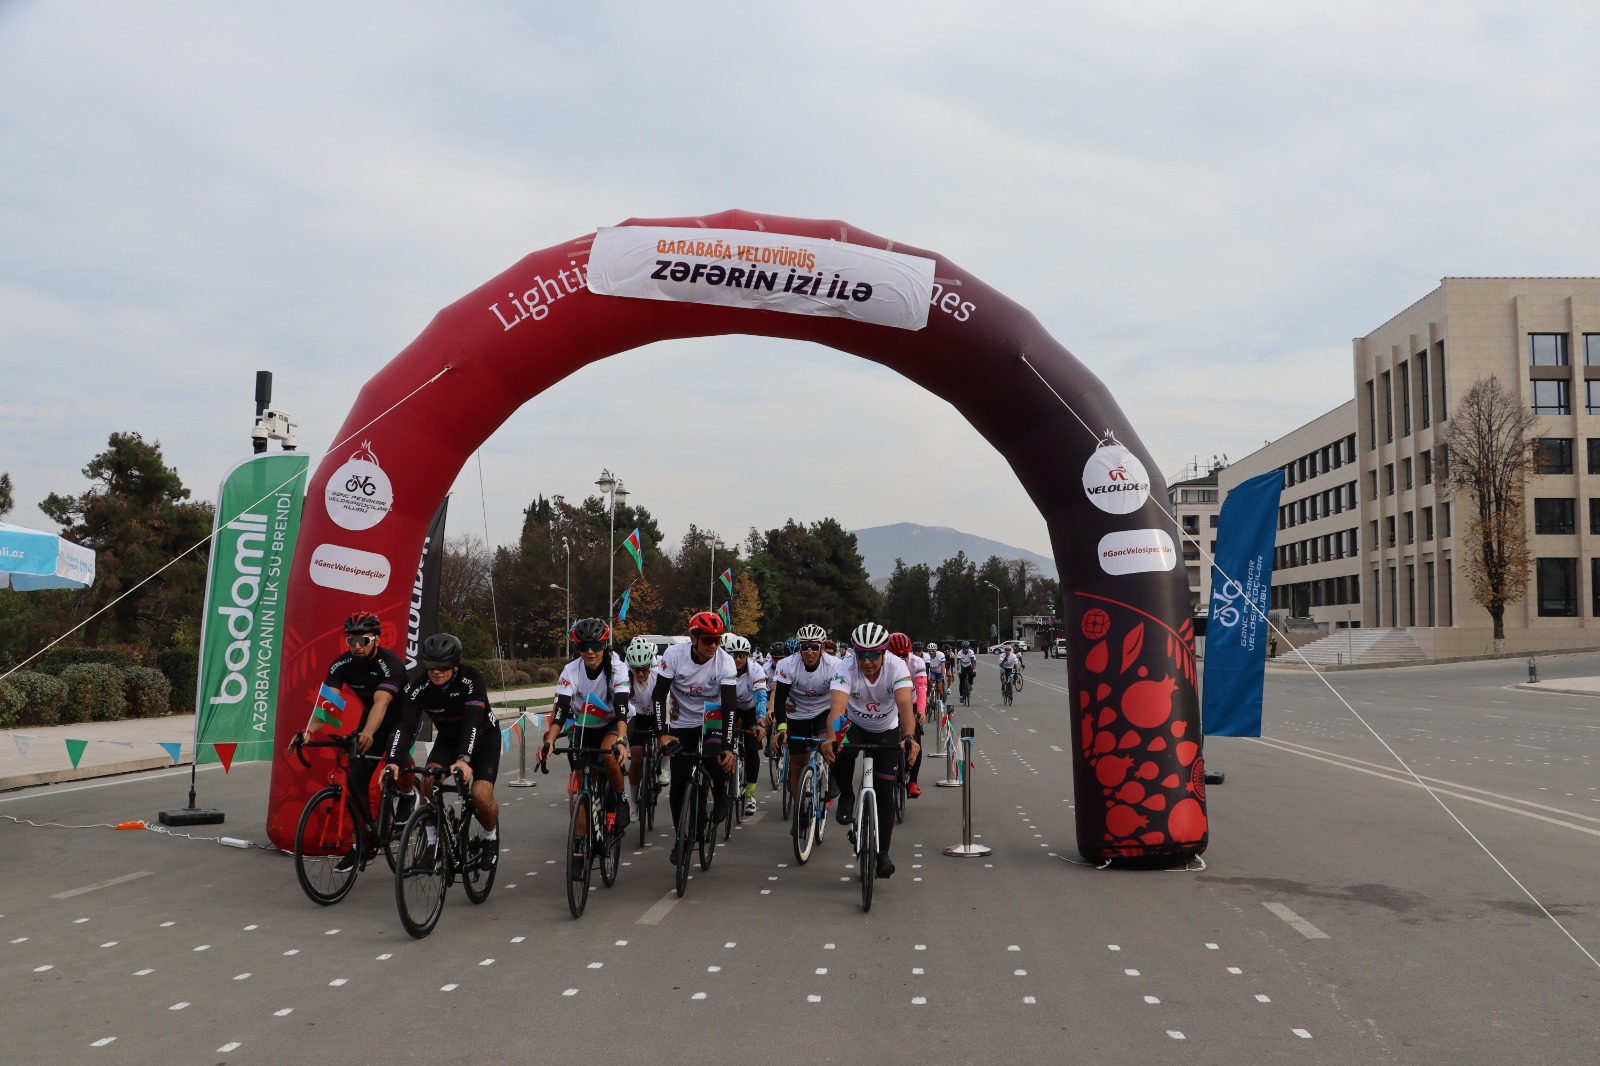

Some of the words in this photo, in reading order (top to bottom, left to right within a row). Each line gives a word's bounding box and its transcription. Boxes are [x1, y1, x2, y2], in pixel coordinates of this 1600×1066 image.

[656, 239, 732, 260] QARABAĞA
[737, 245, 816, 273] VELOYÜRÜŞ
[488, 260, 588, 332] Lighti
[650, 259, 779, 292] ZƏFƏRİN
[783, 268, 824, 297] İZİ
[826, 273, 873, 303] İLƏ
[271, 492, 292, 551] BRENDİ
[268, 556, 282, 577] SU
[260, 581, 279, 606] İLK
[252, 609, 276, 733] AZƏRBAYCANIN
